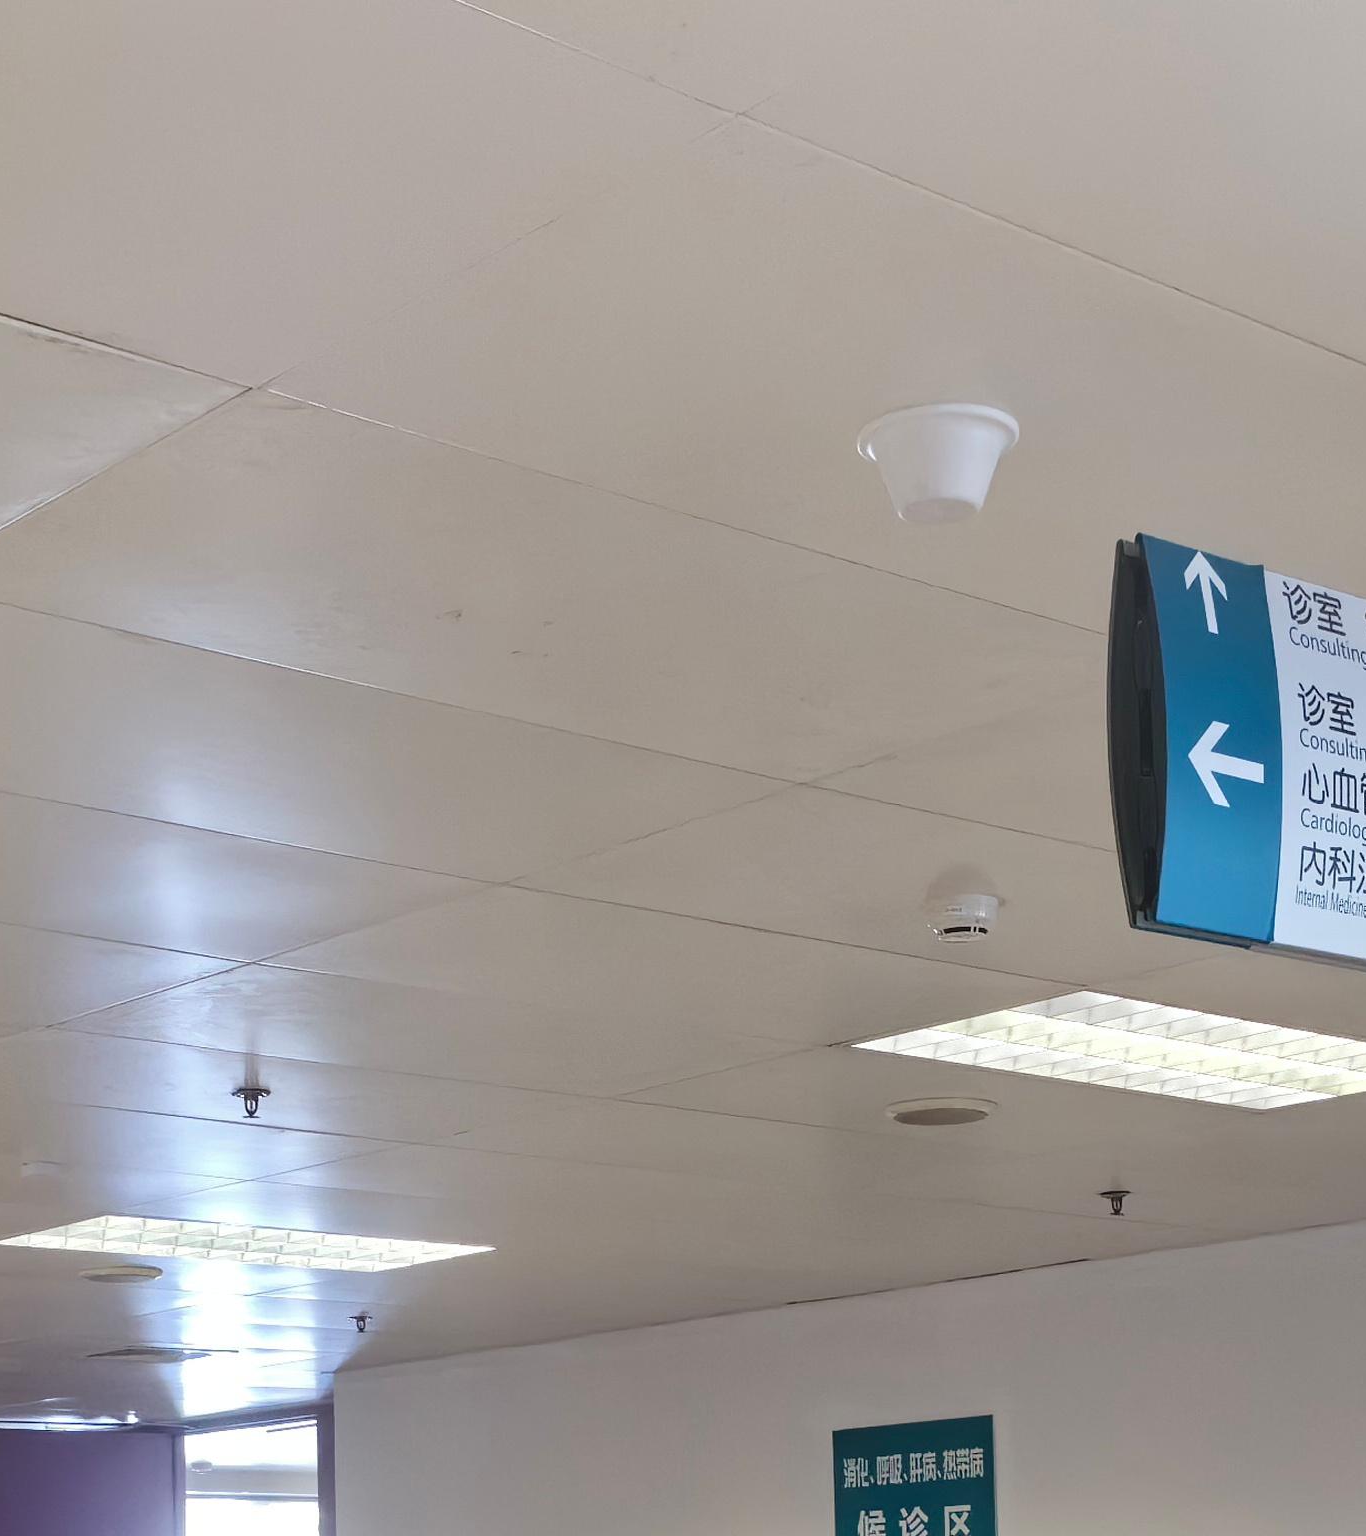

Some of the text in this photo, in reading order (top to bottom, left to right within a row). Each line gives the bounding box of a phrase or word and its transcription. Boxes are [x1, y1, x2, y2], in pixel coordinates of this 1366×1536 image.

[1282, 581, 1346, 636] 诊室
[1298, 682, 1357, 736] 诊室
[1295, 885, 1329, 911] Internal
